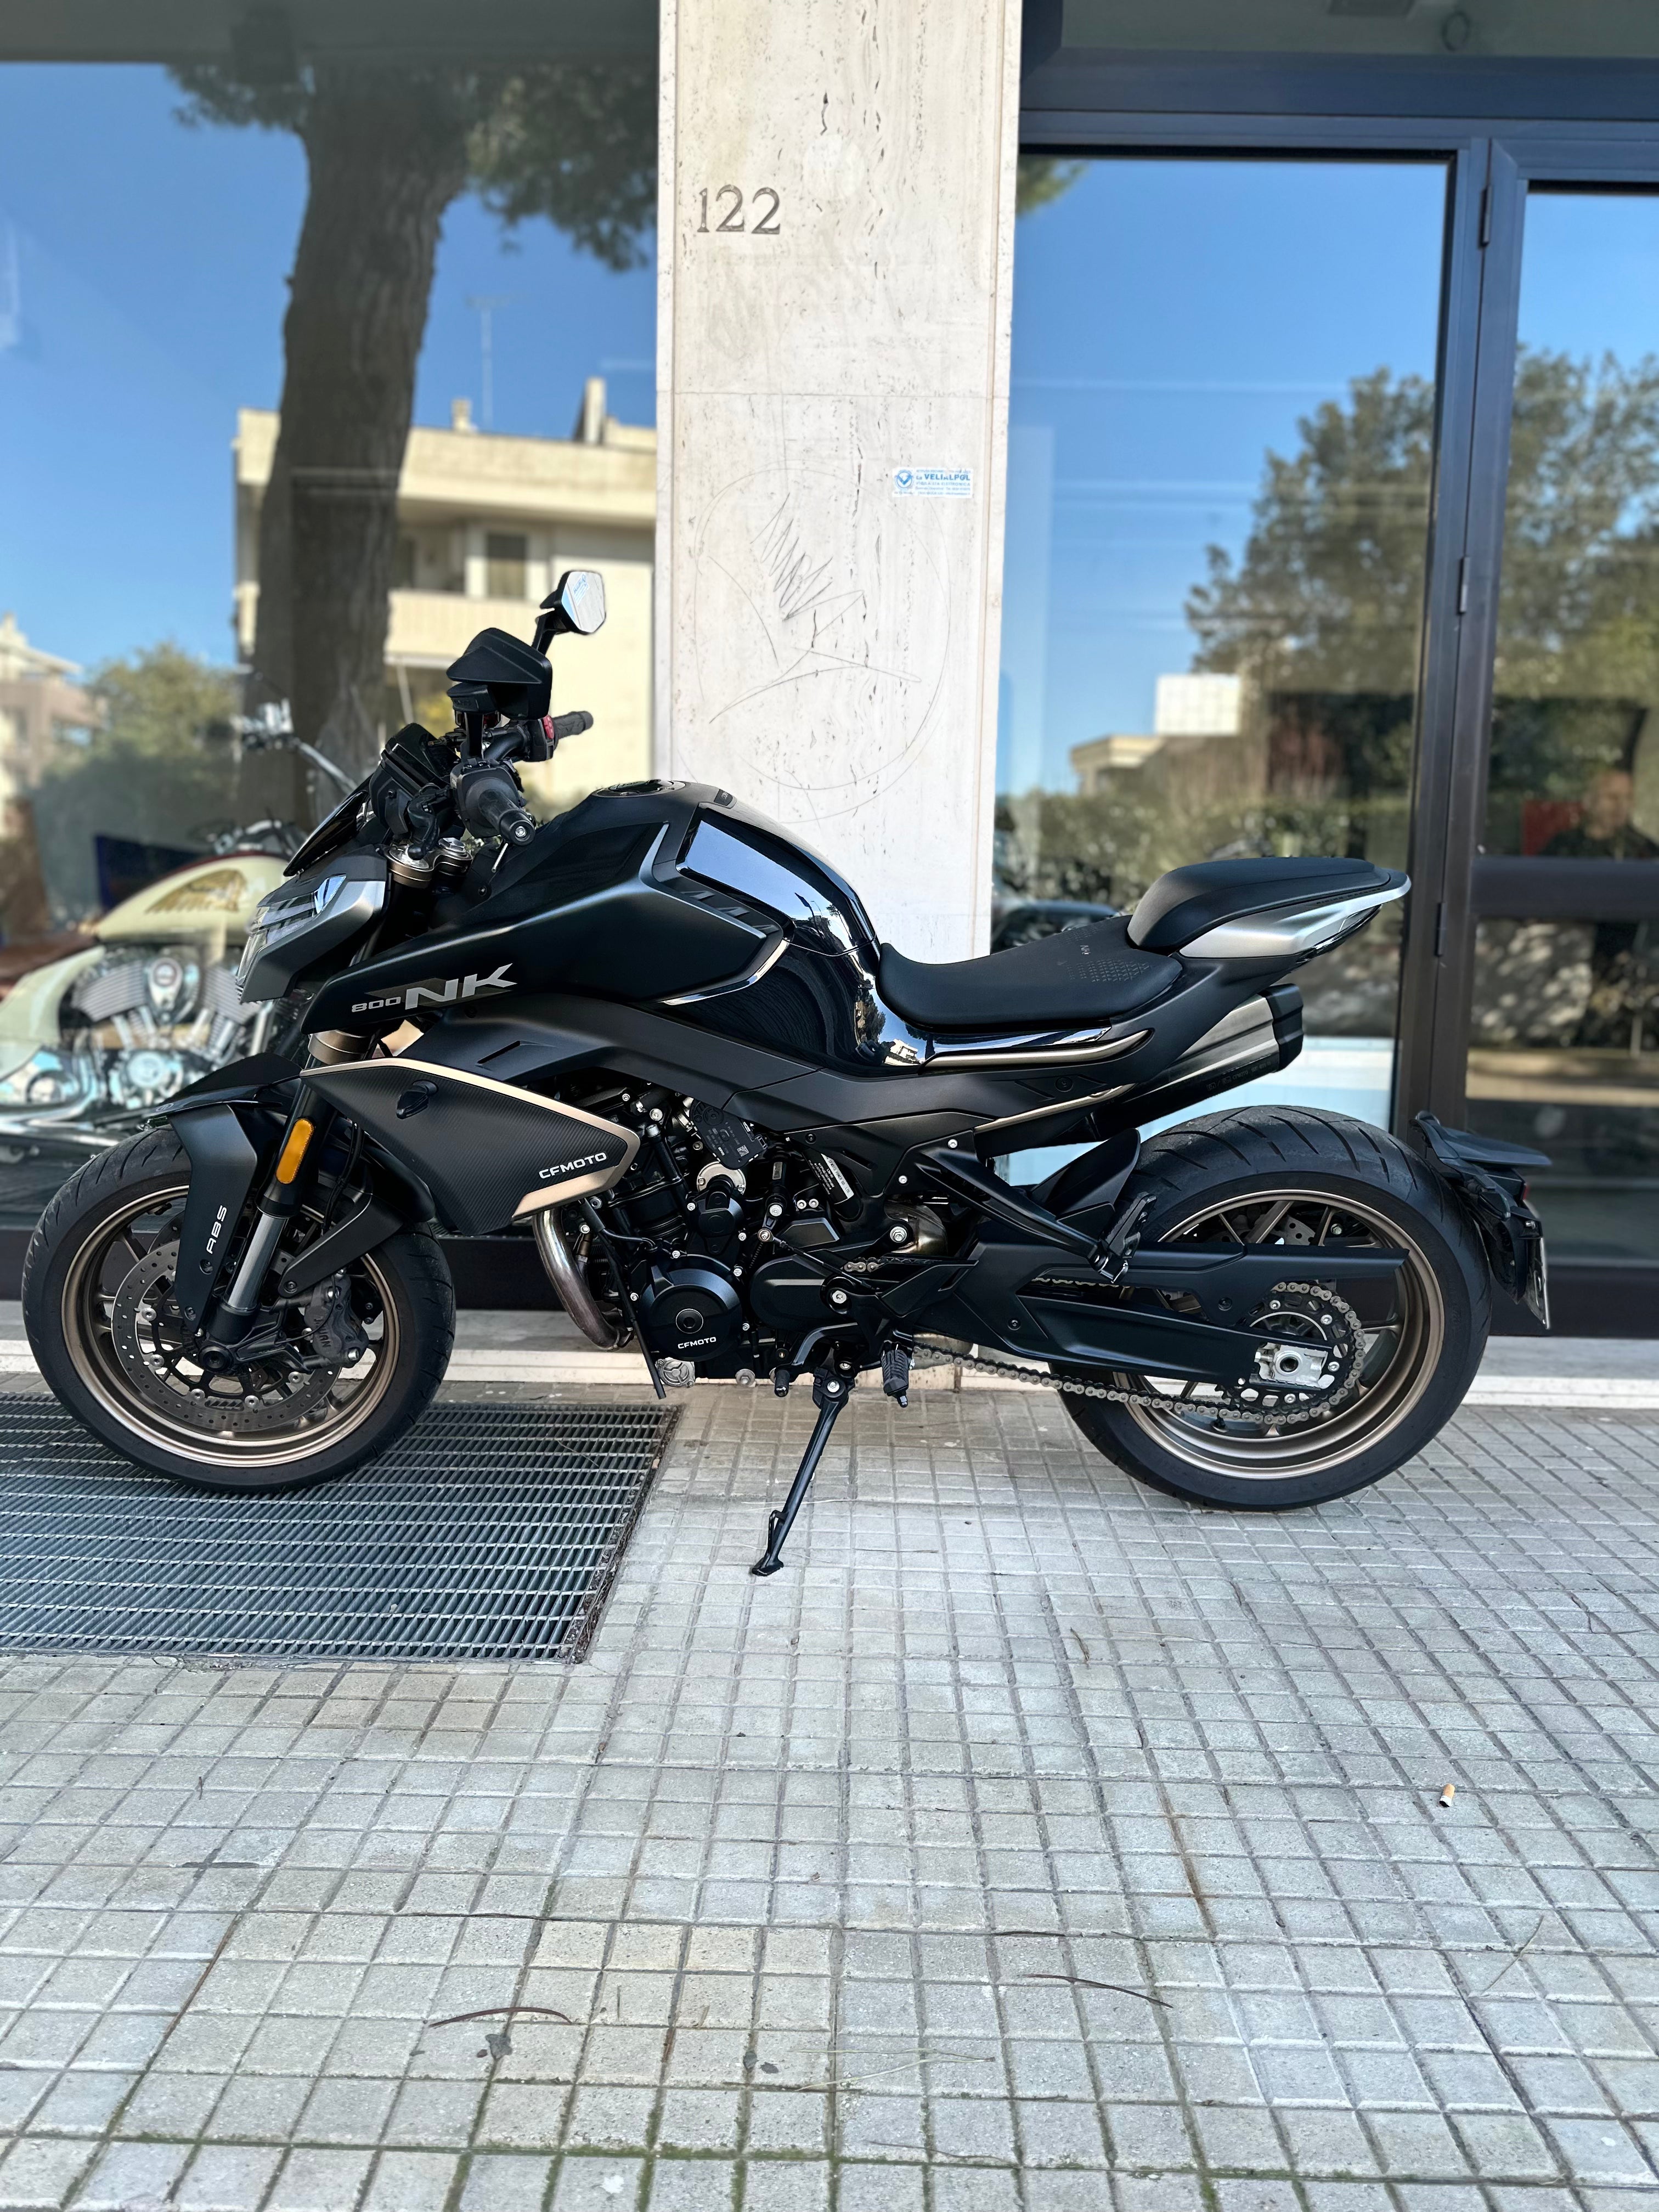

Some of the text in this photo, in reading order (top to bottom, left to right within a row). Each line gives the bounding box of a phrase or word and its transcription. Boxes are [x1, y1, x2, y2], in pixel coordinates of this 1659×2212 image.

[697, 184, 781, 235] 122
[351, 963, 518, 1013] 800 NK
[539, 1152, 607, 1179] CFMOTO
[206, 1205, 227, 1254] ABS
[678, 1336, 716, 1349] CFMOTO
